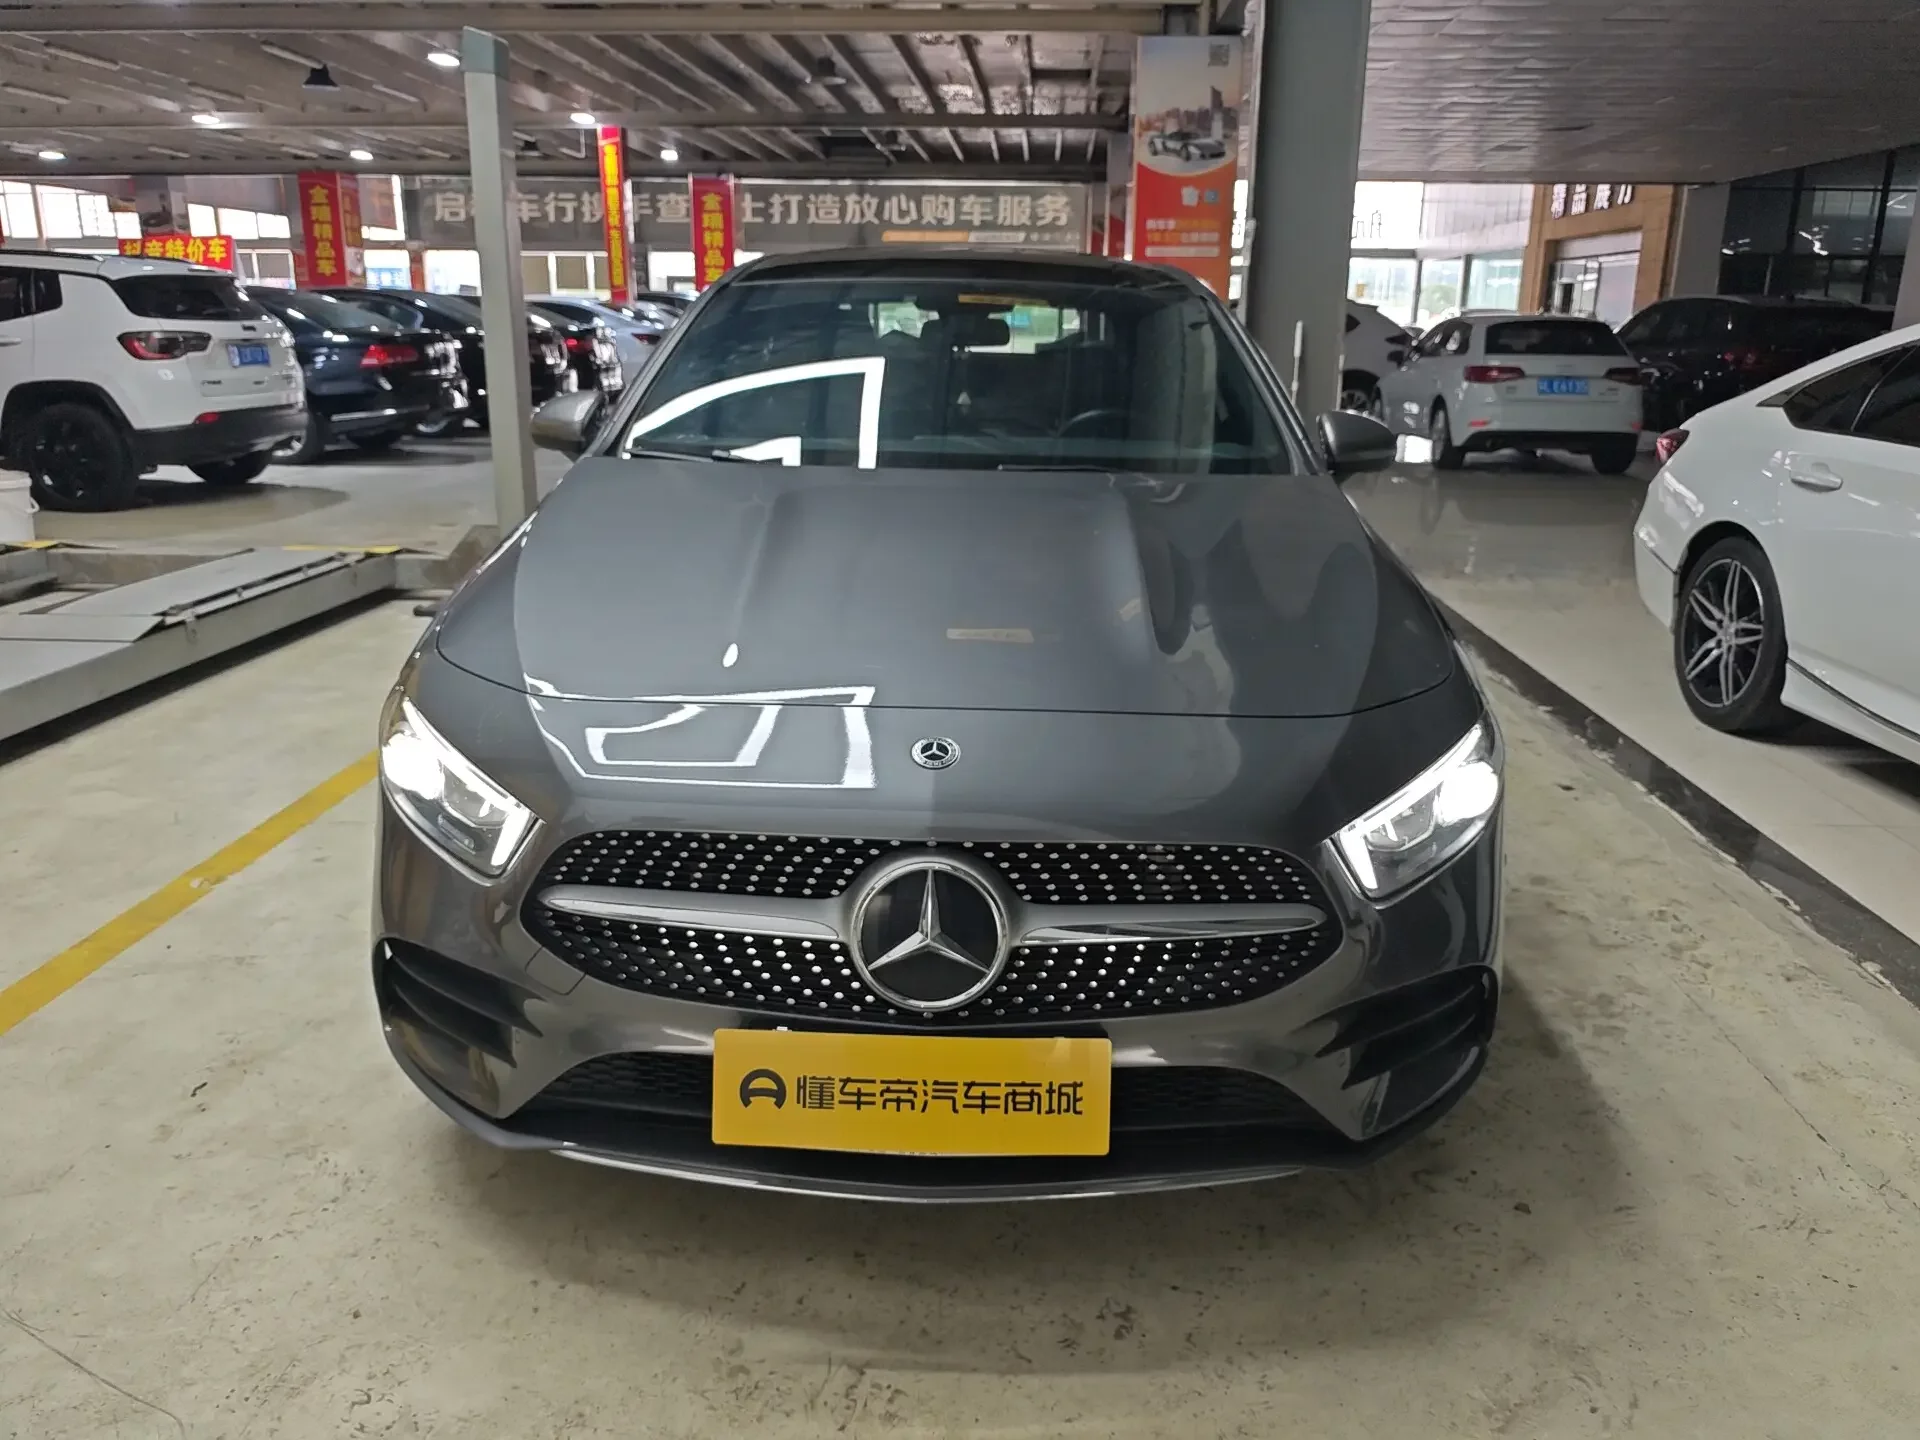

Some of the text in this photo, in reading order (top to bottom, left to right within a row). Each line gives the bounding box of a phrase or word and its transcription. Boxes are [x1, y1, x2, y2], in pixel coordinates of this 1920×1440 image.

[796, 1074, 1084, 1116] 懂车帝汽车商城
